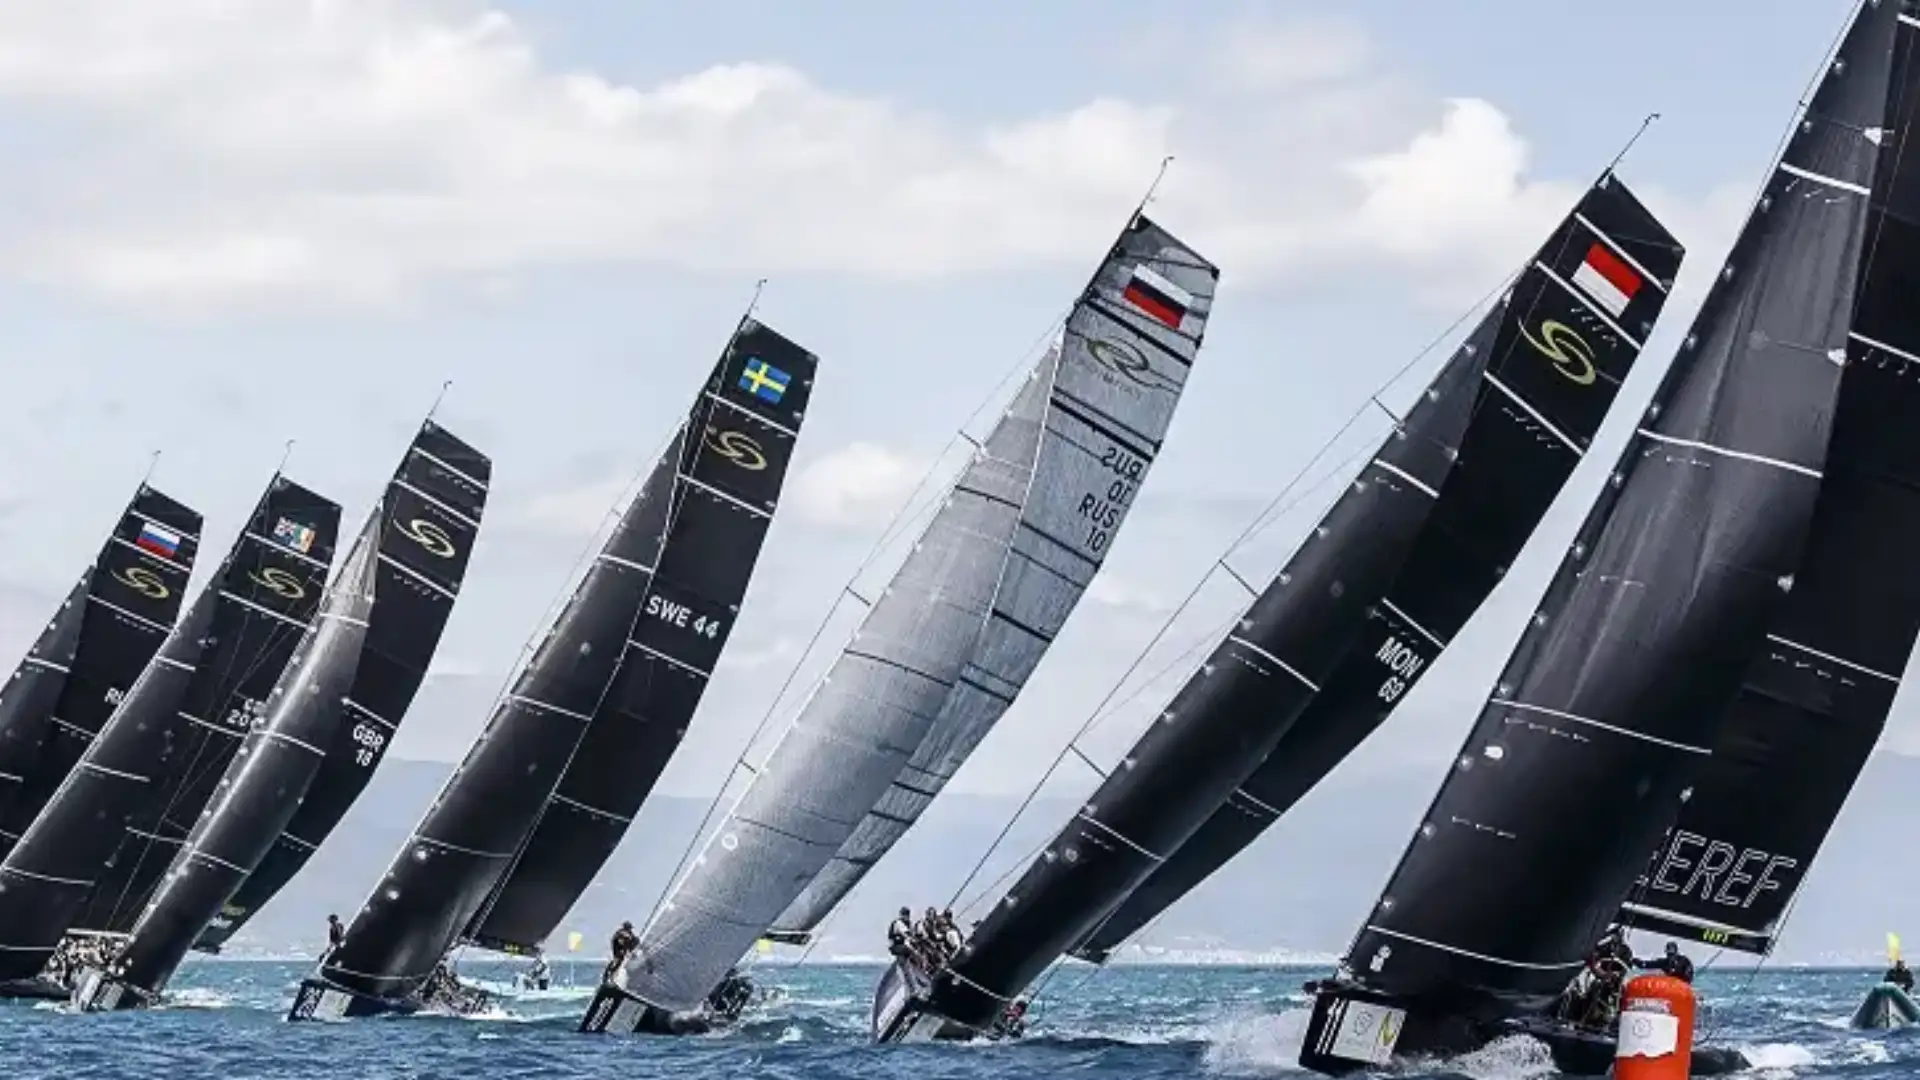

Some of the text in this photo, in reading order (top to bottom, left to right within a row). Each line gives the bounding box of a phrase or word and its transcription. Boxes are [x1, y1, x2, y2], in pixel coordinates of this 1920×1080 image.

[1078, 493, 1119, 529] RUS
[1085, 526, 1107, 552] 10
[645, 595, 720, 639] SWE 44
[1375, 636, 1424, 679] MON
[1378, 676, 1406, 702] 69
[353, 724, 384, 752] GBR
[356, 749, 374, 767] 18
[1635, 826, 1798, 908] EREF
